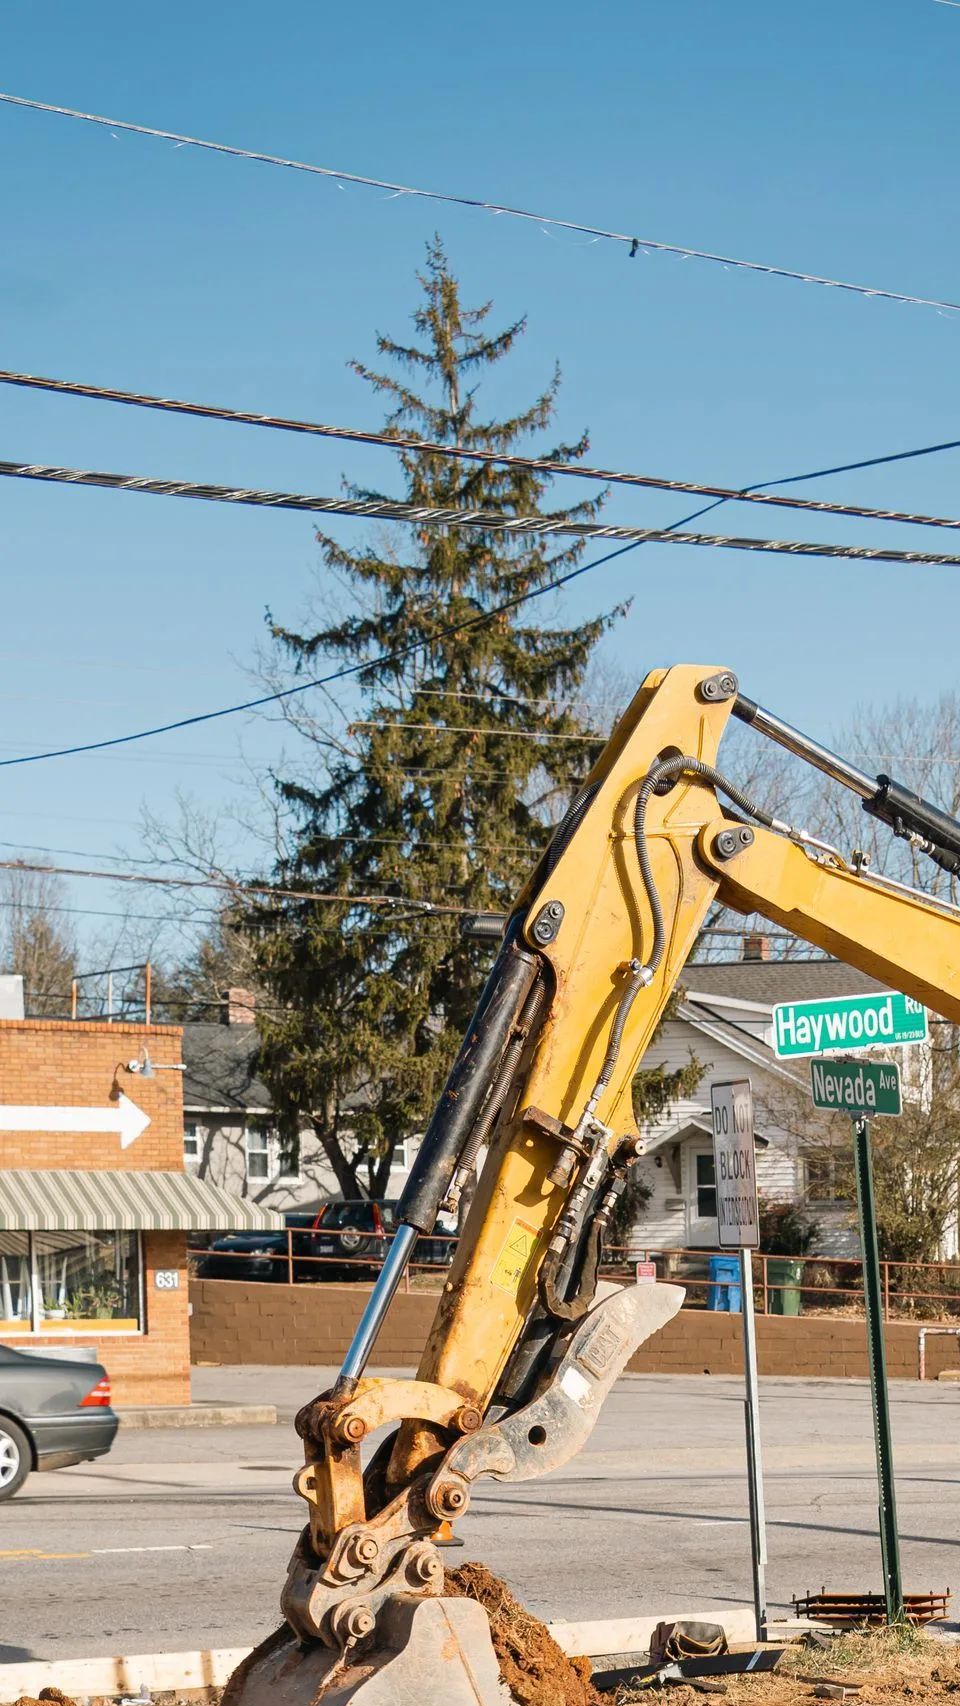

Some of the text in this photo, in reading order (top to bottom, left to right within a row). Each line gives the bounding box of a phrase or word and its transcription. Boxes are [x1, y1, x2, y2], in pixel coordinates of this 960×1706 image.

[777, 997, 894, 1050] Haywood
[813, 1065, 897, 1106] Nevada Ave
[715, 1103, 751, 1135] DO NOT
[720, 1149, 751, 1181] BLOCK
[155, 1271, 178, 1288] 631
